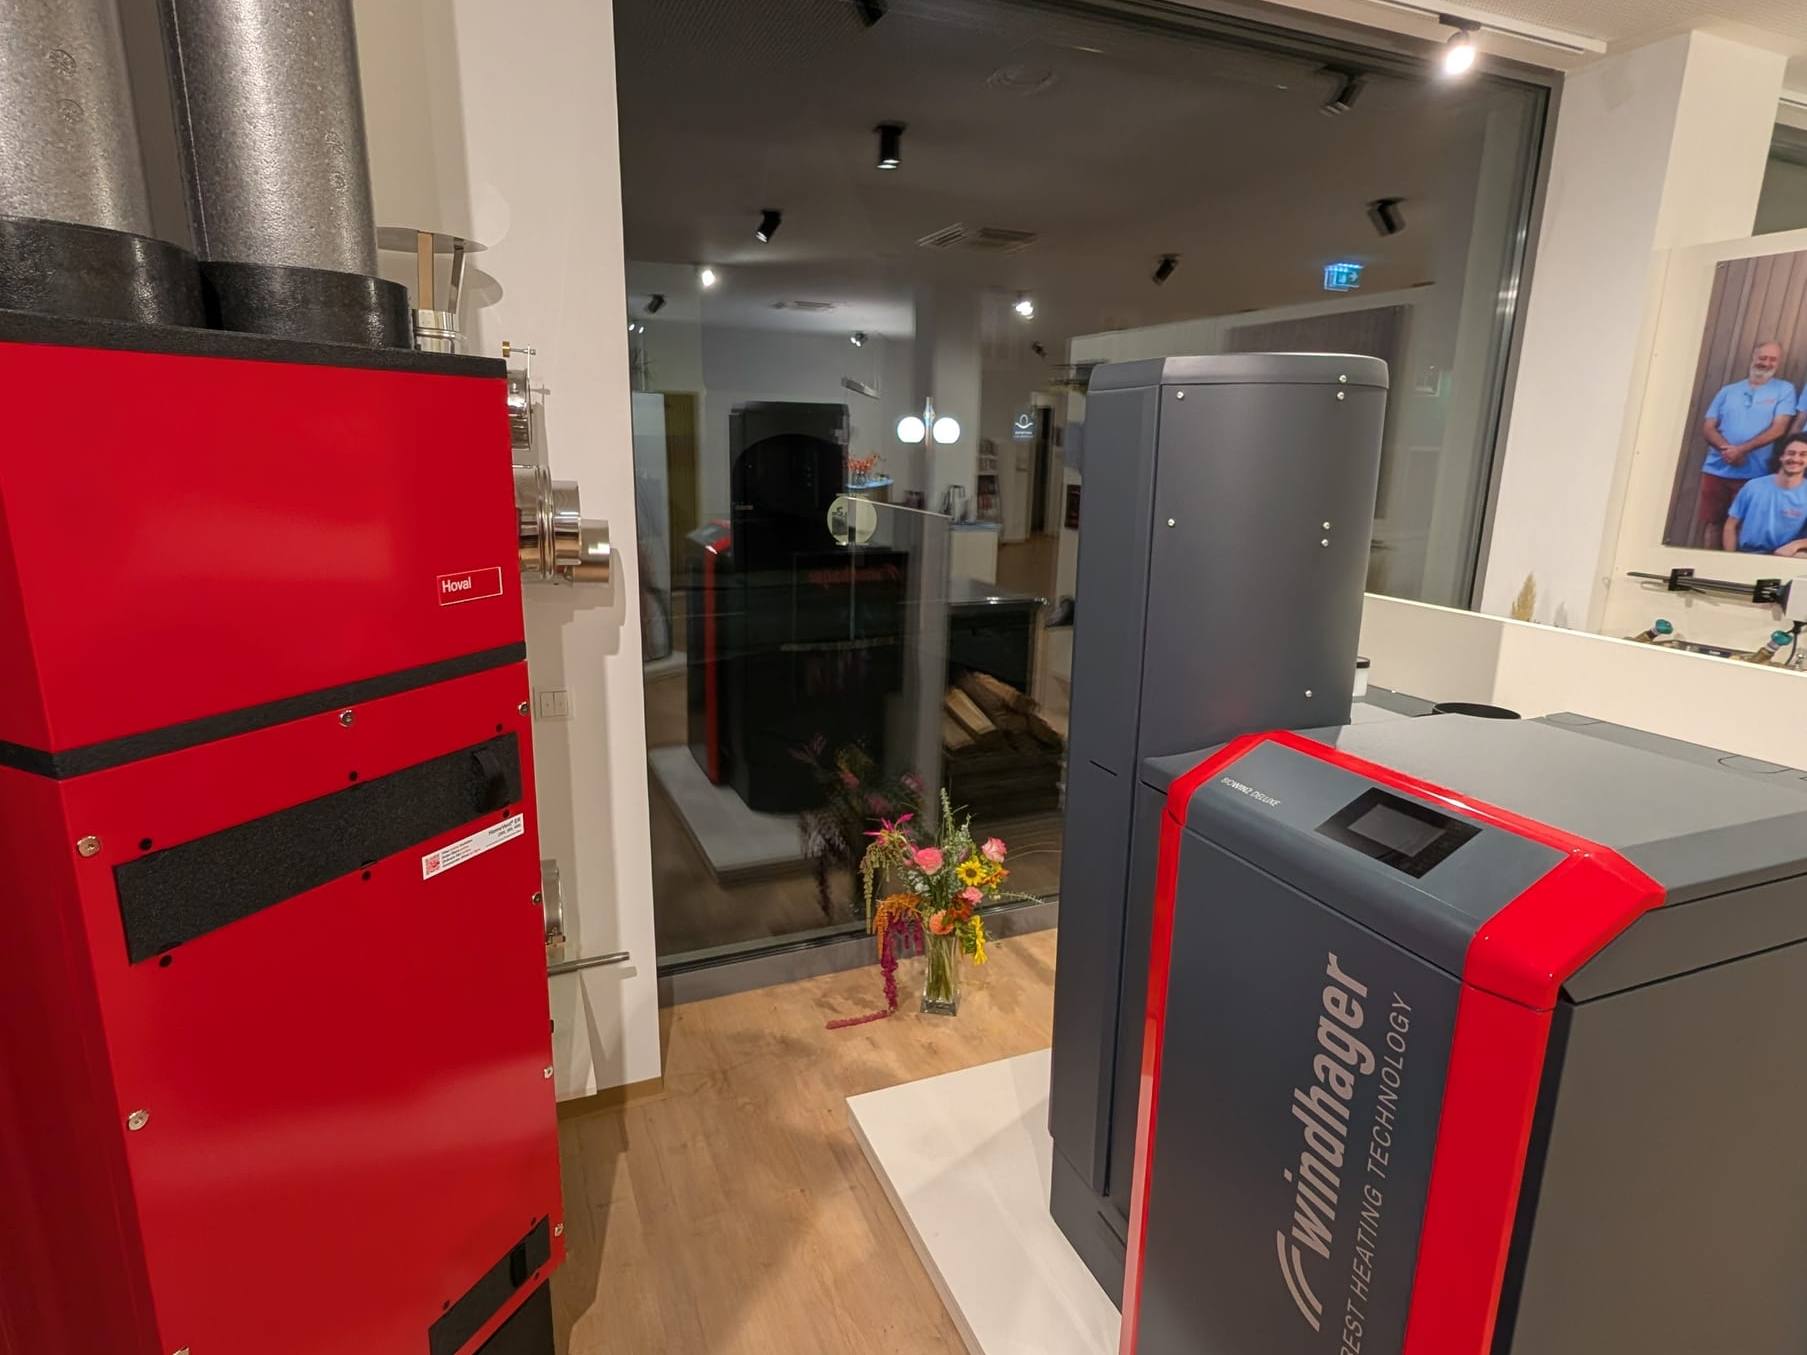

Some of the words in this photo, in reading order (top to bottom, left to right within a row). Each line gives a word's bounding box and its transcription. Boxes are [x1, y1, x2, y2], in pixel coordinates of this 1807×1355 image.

[441, 576, 472, 593] Hoval
[1284, 951, 1376, 1260] windhager
[1350, 1184, 1383, 1302] HEATING
[1367, 991, 1412, 1179] TECHNOLOGY
